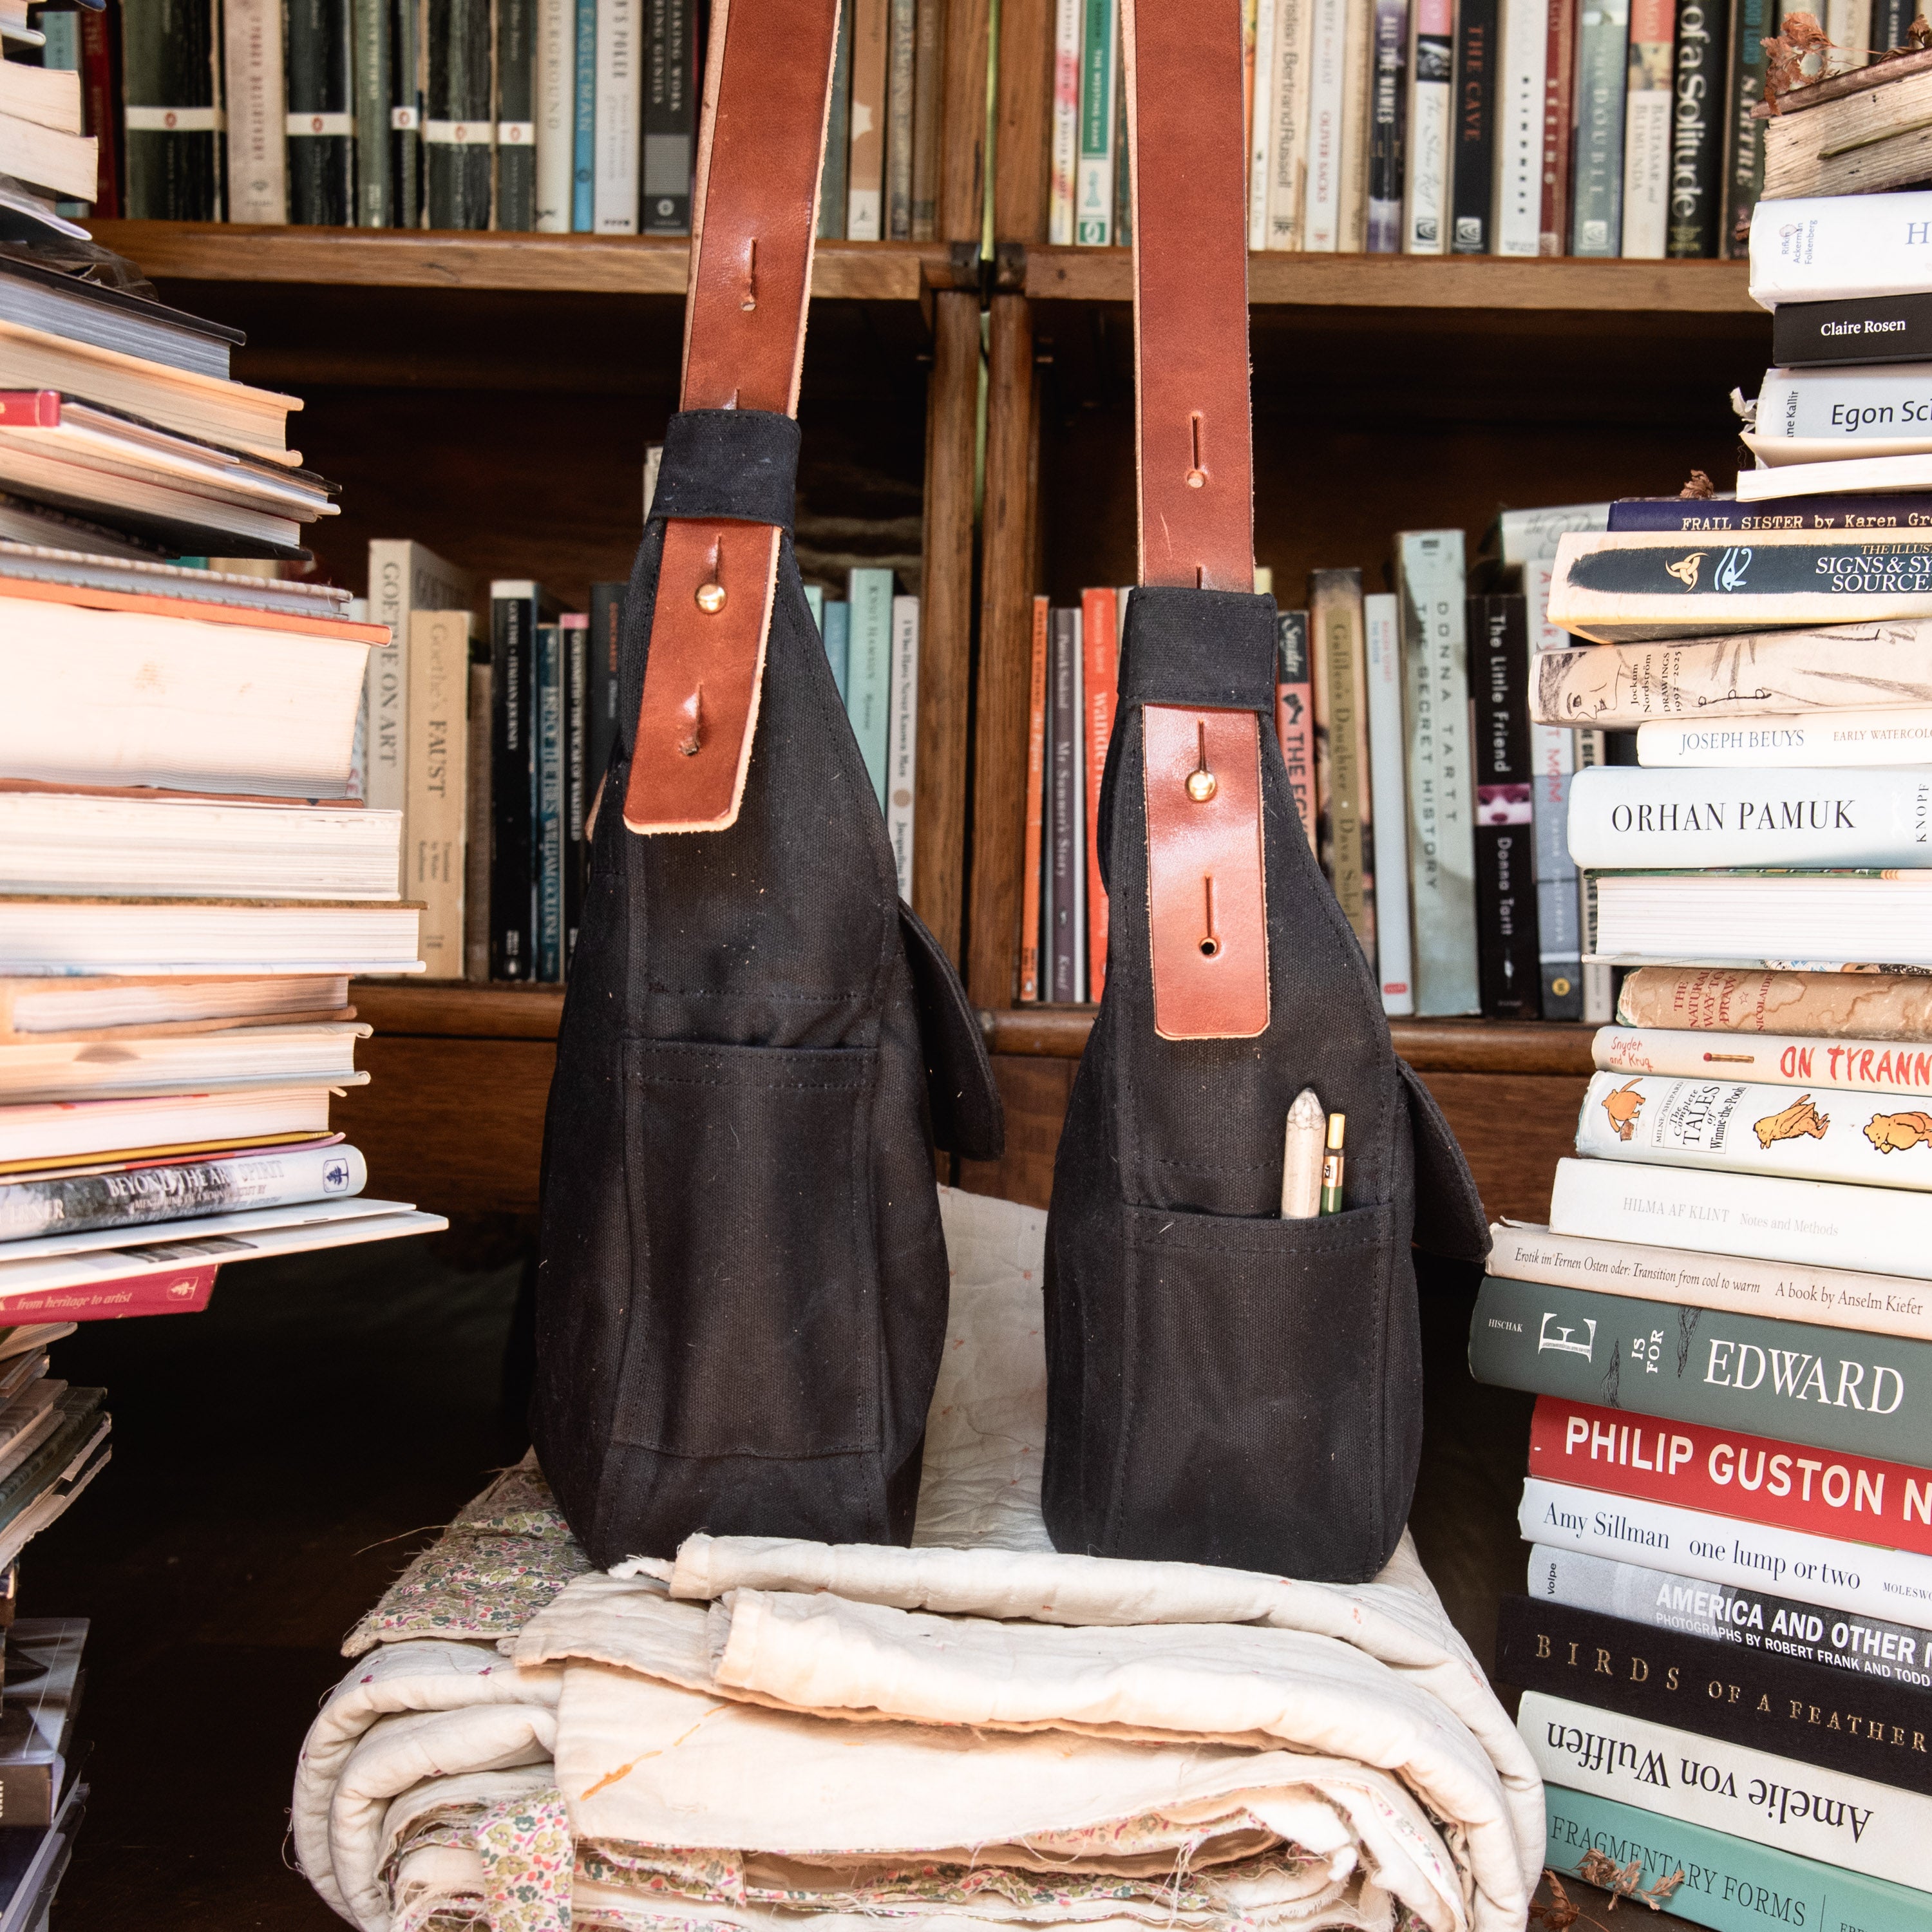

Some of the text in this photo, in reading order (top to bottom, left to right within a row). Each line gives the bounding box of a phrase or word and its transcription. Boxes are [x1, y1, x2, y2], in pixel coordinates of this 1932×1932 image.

[1464, 24, 1484, 142] THE CAVE
[1278, 52, 1299, 189] Bertrand Russell
[1672, 6, 1710, 219] of a Solitude
[1793, 223, 1803, 263] Ackerman
[1804, 220, 1818, 265] Folkenberg
[1821, 320, 1906, 336] Claire Rosen
[1786, 390, 1799, 438] ne Kallir
[1831, 404, 1894, 432] Egon
[1681, 517, 1732, 531] FRAIL
[1741, 516, 1803, 530] SISTER
[1814, 515, 1835, 529] by
[1844, 514, 1897, 528] Karen
[1815, 556, 1884, 574] SIGNS
[1886, 556, 1906, 573] &
[1861, 545, 1889, 555] THE
[1831, 574, 1932, 592] SOURCE
[1332, 623, 1350, 701] Galileo's
[1629, 663, 1640, 706] Jockum
[1641, 654, 1652, 713] Nordström
[1661, 652, 1671, 712] DRAWINGS
[1436, 601, 1457, 823] DONNA TARTT
[1489, 614, 1512, 773] The Little Friend
[428, 719, 448, 798] FAUST
[1287, 732, 1306, 778] THE
[1334, 707, 1354, 790] Daughter
[1416, 604, 1439, 890] THE SECRET HISTORY
[1679, 730, 1804, 755] JOSEPH BEUYS
[1833, 730, 1867, 741] EARLY
[1547, 748, 1563, 803] MOM
[1611, 799, 1857, 833] ORHAN PAMUK
[1915, 783, 1930, 843] KNOPF
[1338, 818, 1358, 863] Dava
[1497, 837, 1515, 935] Donna Tartt
[1674, 981, 1689, 1012] THE
[1689, 970, 1712, 1028] NATURAL
[1703, 971, 1725, 1028] WAY TO
[1718, 975, 1737, 1023] DRAW
[1756, 971, 1778, 1031] NICOLAIDES
[1609, 1052, 1654, 1072] and Krug
[1611, 1036, 1643, 1056] Snyder
[1780, 1044, 1932, 1086] ON TYRANN
[1656, 1081, 1684, 1143] MILNE/SHEPARD
[1669, 1106, 1682, 1126] The
[1674, 1088, 1698, 1137] Complete
[1682, 1086, 1720, 1146] TALES
[1706, 1109, 1717, 1125] of
[1710, 1086, 1747, 1150] Winnie-the-Pooh
[1622, 1197, 1730, 1222] HILMA AF KLINT
[1739, 1213, 1839, 1236] Notes and Methods
[1514, 1247, 1761, 1294] Erotik im Fernen Osten oder: Transition from cool to warm
[91, 1294, 102, 1305] to
[103, 1291, 133, 1304] artist
[1774, 1281, 1923, 1315] A book by Anselm Kiefer
[1488, 1318, 1524, 1333] HISCHAK
[1538, 1312, 1904, 1415] E IS FOR EDWARD
[1565, 1416, 1694, 1476] PHILIP
[1707, 1442, 1886, 1516] GUSTON
[1543, 1501, 1588, 1538] Amy
[1593, 1511, 1670, 1551] Sillman
[1689, 1539, 1727, 1562] one
[1732, 1540, 1786, 1582] lump
[1793, 1561, 1817, 1581] or
[1821, 1562, 1861, 1590] two
[1547, 1562, 1557, 1595] Volpe
[1655, 1582, 1917, 1664] AMERICA AND OTHER
[1655, 1611, 1931, 1688] PHOTOGRAPHS BY ROBERT FRANK AND TODD
[1535, 1633, 1927, 1754] BIRDS OF A FEATHER
[1546, 1721, 1875, 1844] Amelie von Wulffen
[1550, 1815, 1806, 1927] FRAGMENTARY FORMS
